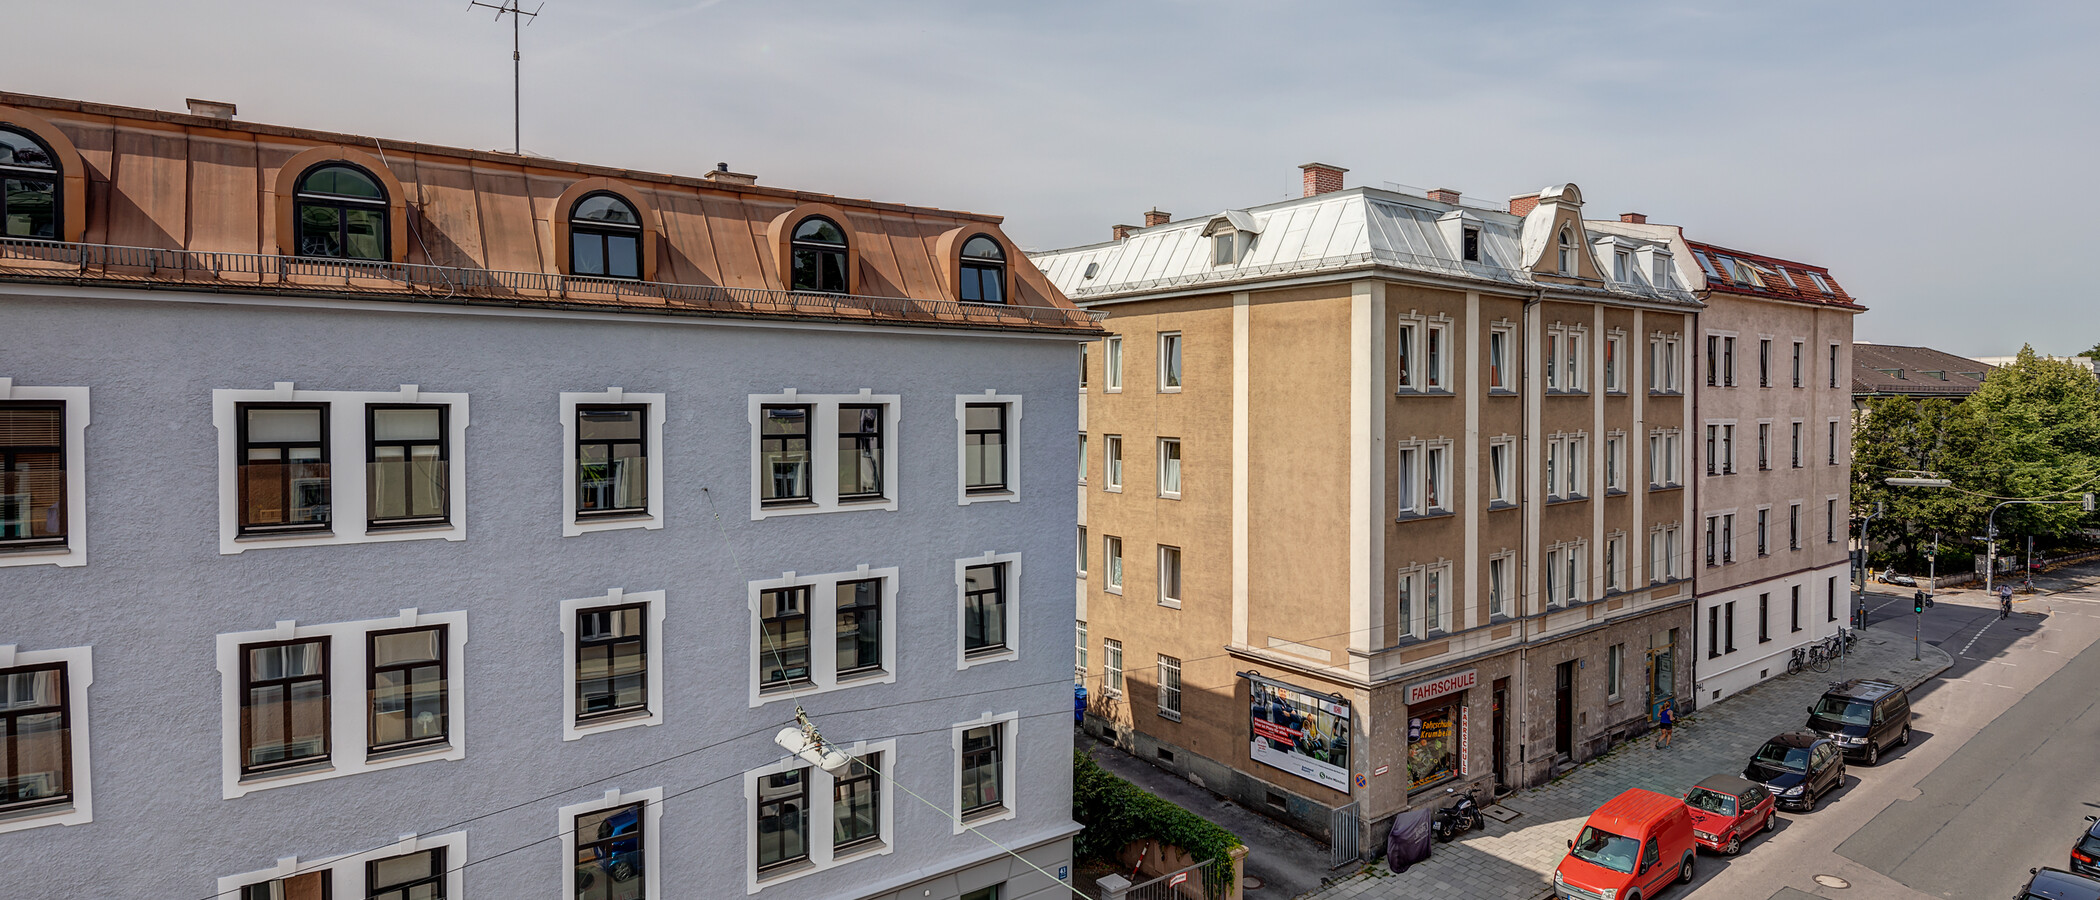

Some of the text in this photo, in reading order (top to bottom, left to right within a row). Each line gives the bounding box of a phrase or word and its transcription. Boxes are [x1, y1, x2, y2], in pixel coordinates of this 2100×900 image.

[1412, 672, 1475, 701] FAHRSCHULE
[1422, 720, 1453, 730] Fahrschule
[1420, 729, 1452, 739] Krumbein
